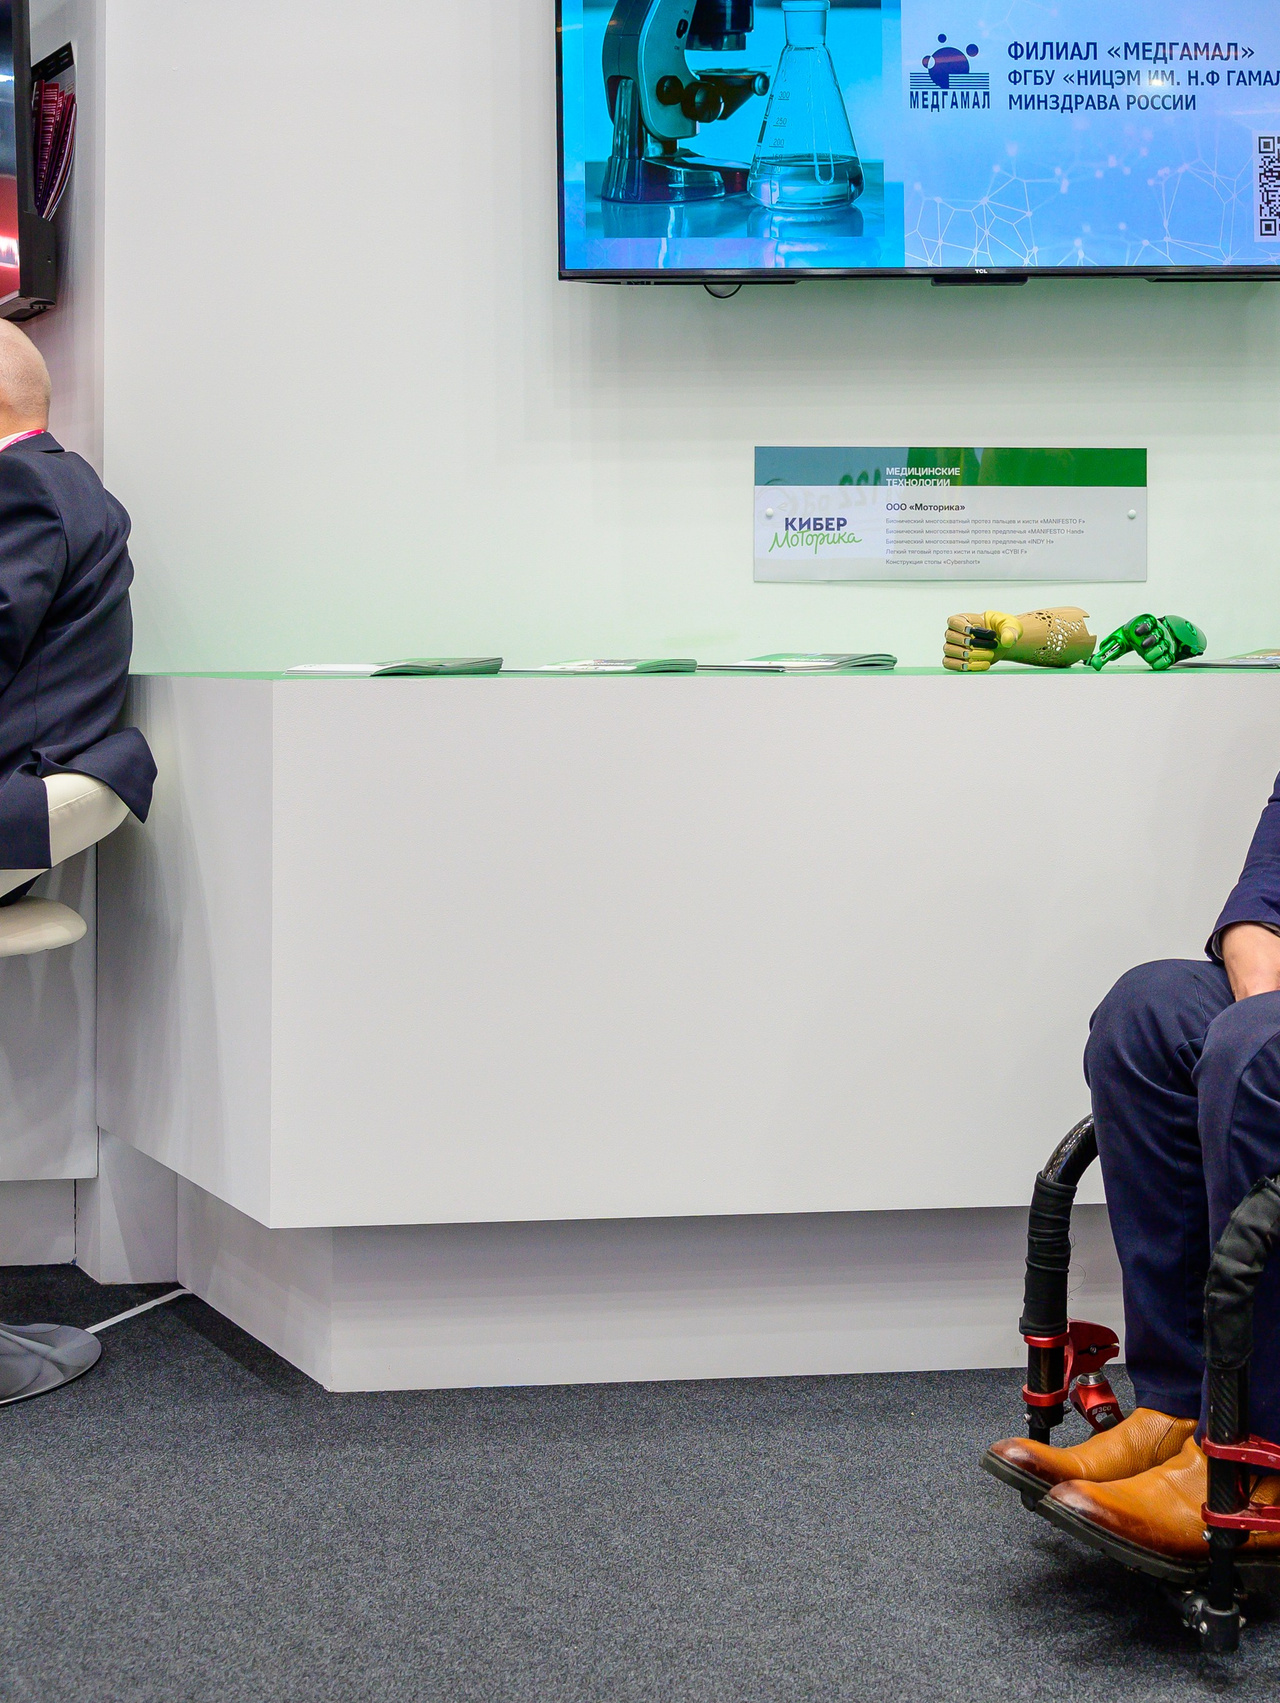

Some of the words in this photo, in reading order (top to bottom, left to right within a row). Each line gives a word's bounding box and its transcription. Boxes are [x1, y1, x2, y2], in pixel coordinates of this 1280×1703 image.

[1007, 41, 1098, 61] ФИЛИАЛ
[1107, 42, 1255, 64] «МЕДГАМАЛ»
[1007, 70, 1056, 86] ФГБУ
[1063, 70, 1141, 89] «НИЦЭМ
[1148, 70, 1181, 86] ИМ.
[1187, 70, 1220, 86] Н.Ф
[909, 91, 991, 112] МЕДГАМАЛ
[1008, 94, 1121, 113] МИНЗДРАВА
[1126, 94, 1197, 111] РОССИИ
[886, 467, 960, 476] МЕДИЦИНСКИЕ
[886, 478, 951, 486] ТЕХНОЛОГИИ
[886, 503, 907, 511] ООО
[909, 503, 966, 512] «Моторика»
[785, 517, 847, 531] КИБЕР
[768, 529, 863, 554] Моторика
